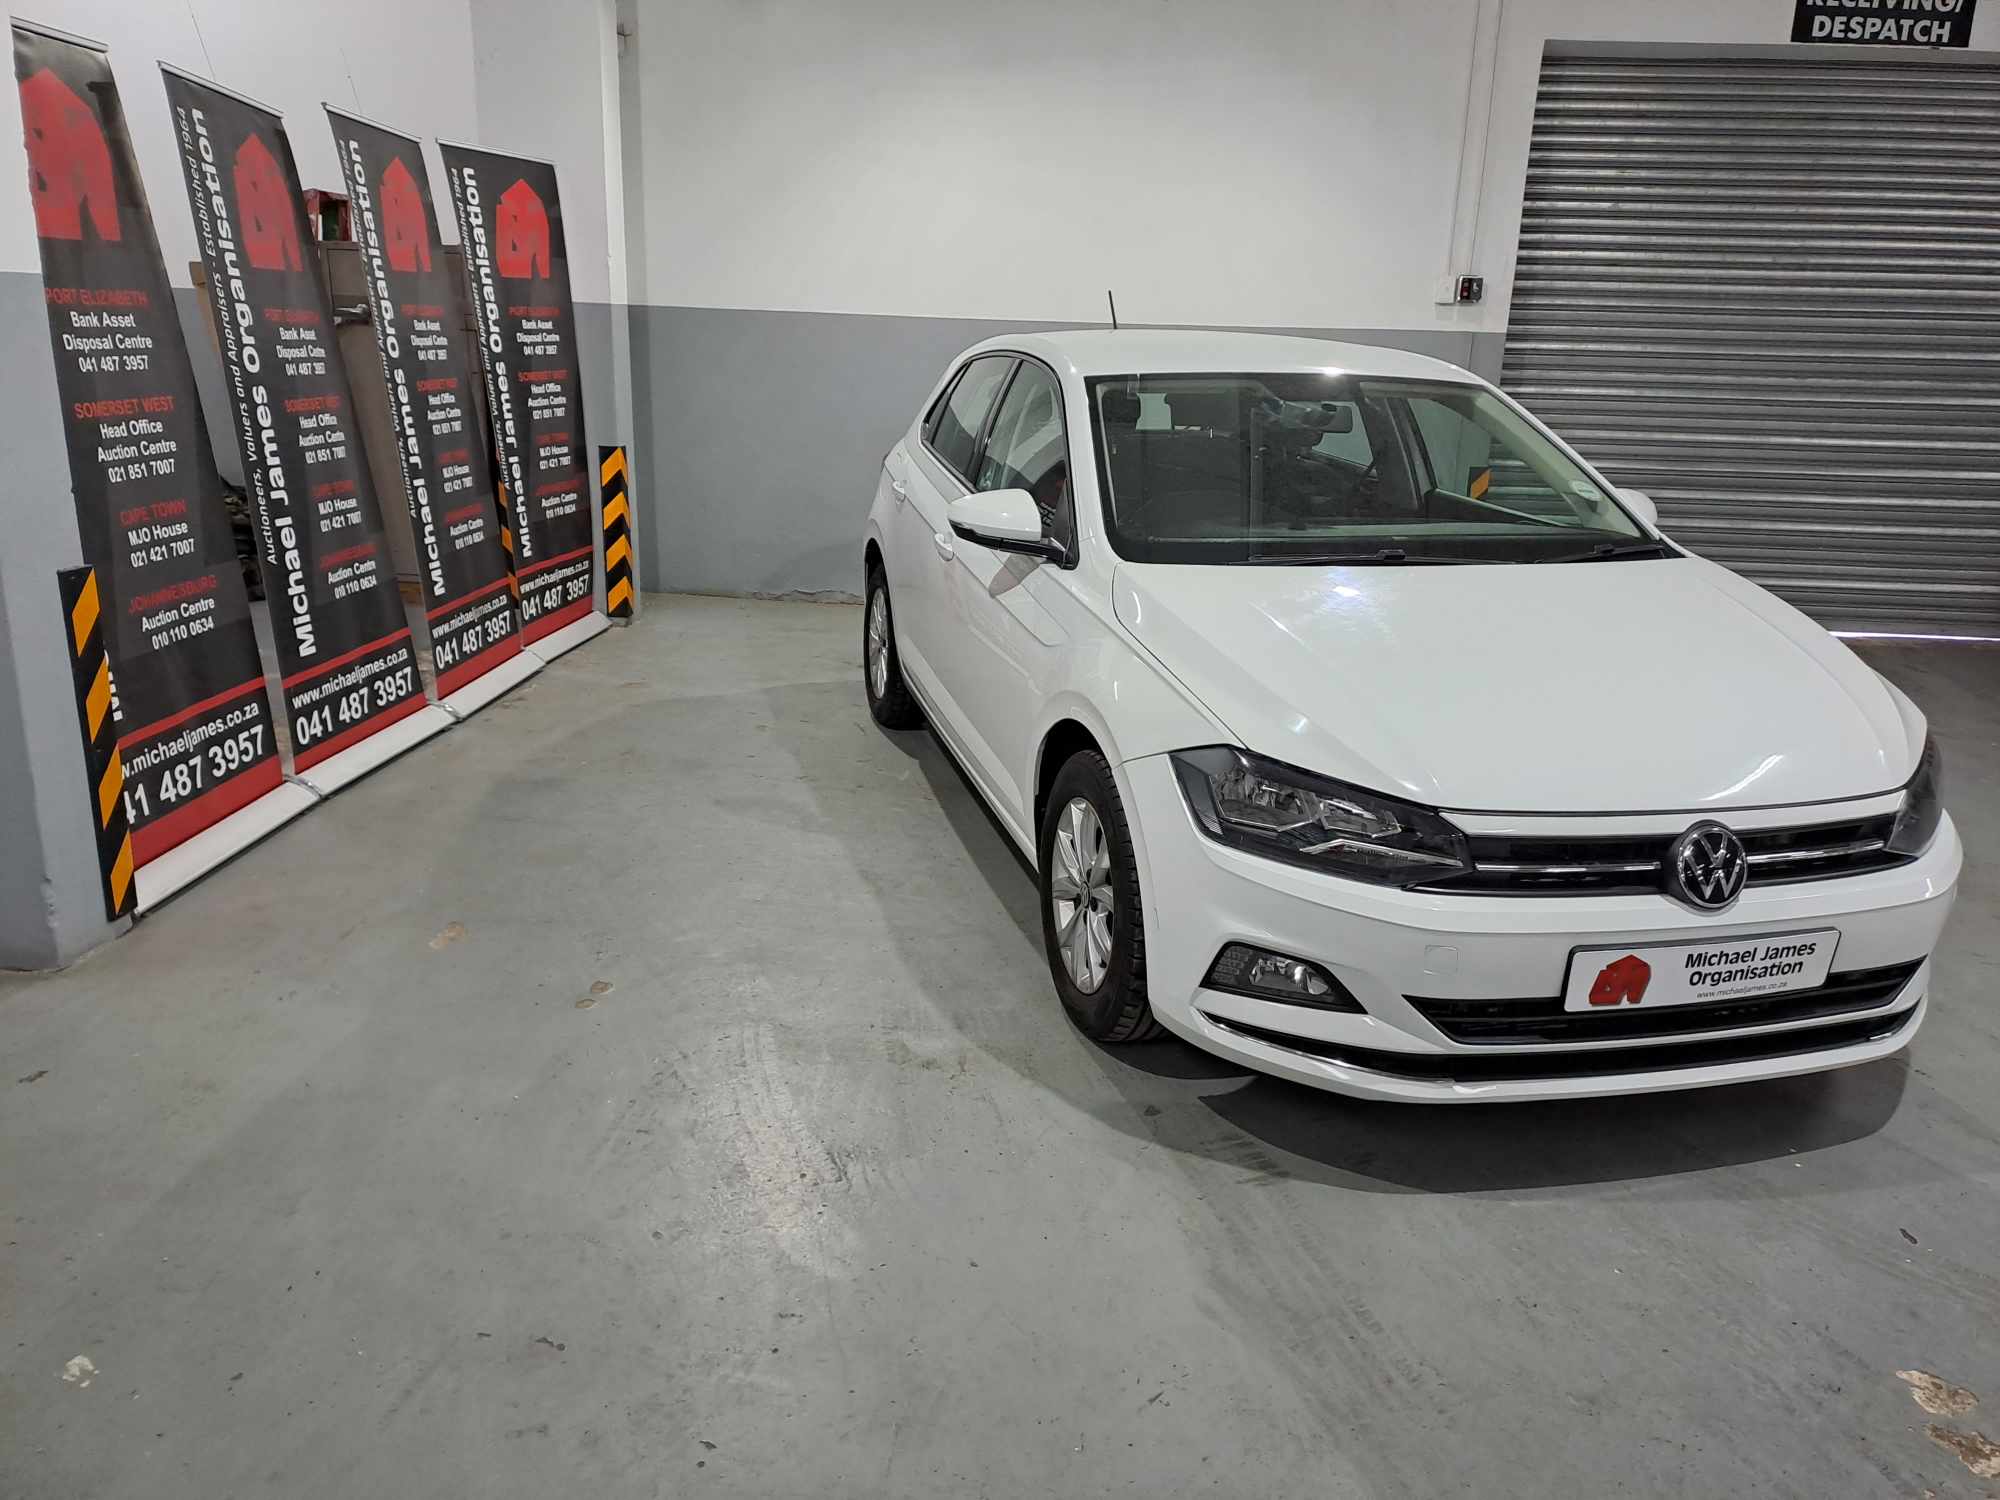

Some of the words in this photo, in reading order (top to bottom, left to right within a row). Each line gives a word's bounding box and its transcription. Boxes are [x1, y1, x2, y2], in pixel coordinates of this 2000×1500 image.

[1811, 15, 1951, 43] DESPATCH
[176, 105, 193, 150] 1964
[185, 154, 217, 257] Established
[191, 107, 260, 374] Organisation
[349, 140, 400, 359] Organisation
[463, 167, 503, 353] Organisation
[70, 311, 100, 328] Bank
[102, 312, 136, 328] Asset
[213, 272, 238, 362] Appraisers
[279, 327, 299, 340] Bank
[62, 334, 113, 353] Disposal
[115, 335, 153, 349] Centre
[78, 356, 98, 373] 041
[100, 356, 119, 371] 487
[123, 355, 149, 371] 3957
[229, 364, 245, 397] and
[74, 398, 138, 418] SOMERSET
[143, 396, 175, 412] WEST
[393, 368, 422, 469] James
[495, 361, 517, 449] James
[97, 444, 138, 462] Auction
[140, 439, 177, 456] Centre
[99, 423, 127, 439] Head
[129, 419, 163, 436] Office
[238, 402, 258, 462] Valuers
[252, 385, 289, 506] James
[108, 466, 127, 483] 021
[129, 463, 148, 478] 851
[150, 458, 175, 475] 7007
[153, 499, 187, 519] TOWN
[253, 468, 278, 566] Auctioneers,
[508, 456, 532, 557] Michael
[128, 528, 151, 546] MJO
[152, 522, 188, 541] House
[130, 549, 148, 568] 021
[150, 544, 168, 562] 421
[171, 538, 195, 556] 7007
[412, 478, 446, 596] Michael
[274, 516, 317, 658] Michael
[522, 595, 542, 621] 041
[543, 584, 562, 611] 487
[566, 574, 589, 601] 3957
[142, 608, 179, 632] Auction
[180, 598, 215, 618] Centre
[152, 631, 169, 650] 010
[170, 626, 187, 643] 110
[189, 615, 215, 635] 0634
[435, 637, 460, 670] 041
[462, 625, 483, 655] 487
[484, 610, 511, 642] 3957
[292, 648, 408, 709] www.michaeljames.co.za
[296, 705, 333, 745] 041
[339, 687, 369, 723] 487
[374, 666, 412, 706] 3957
[160, 755, 202, 802] 487
[208, 724, 264, 777] 3957
[1684, 947, 1758, 969] Michael
[1760, 942, 1817, 961] James
[1689, 960, 1804, 987] Organisation
